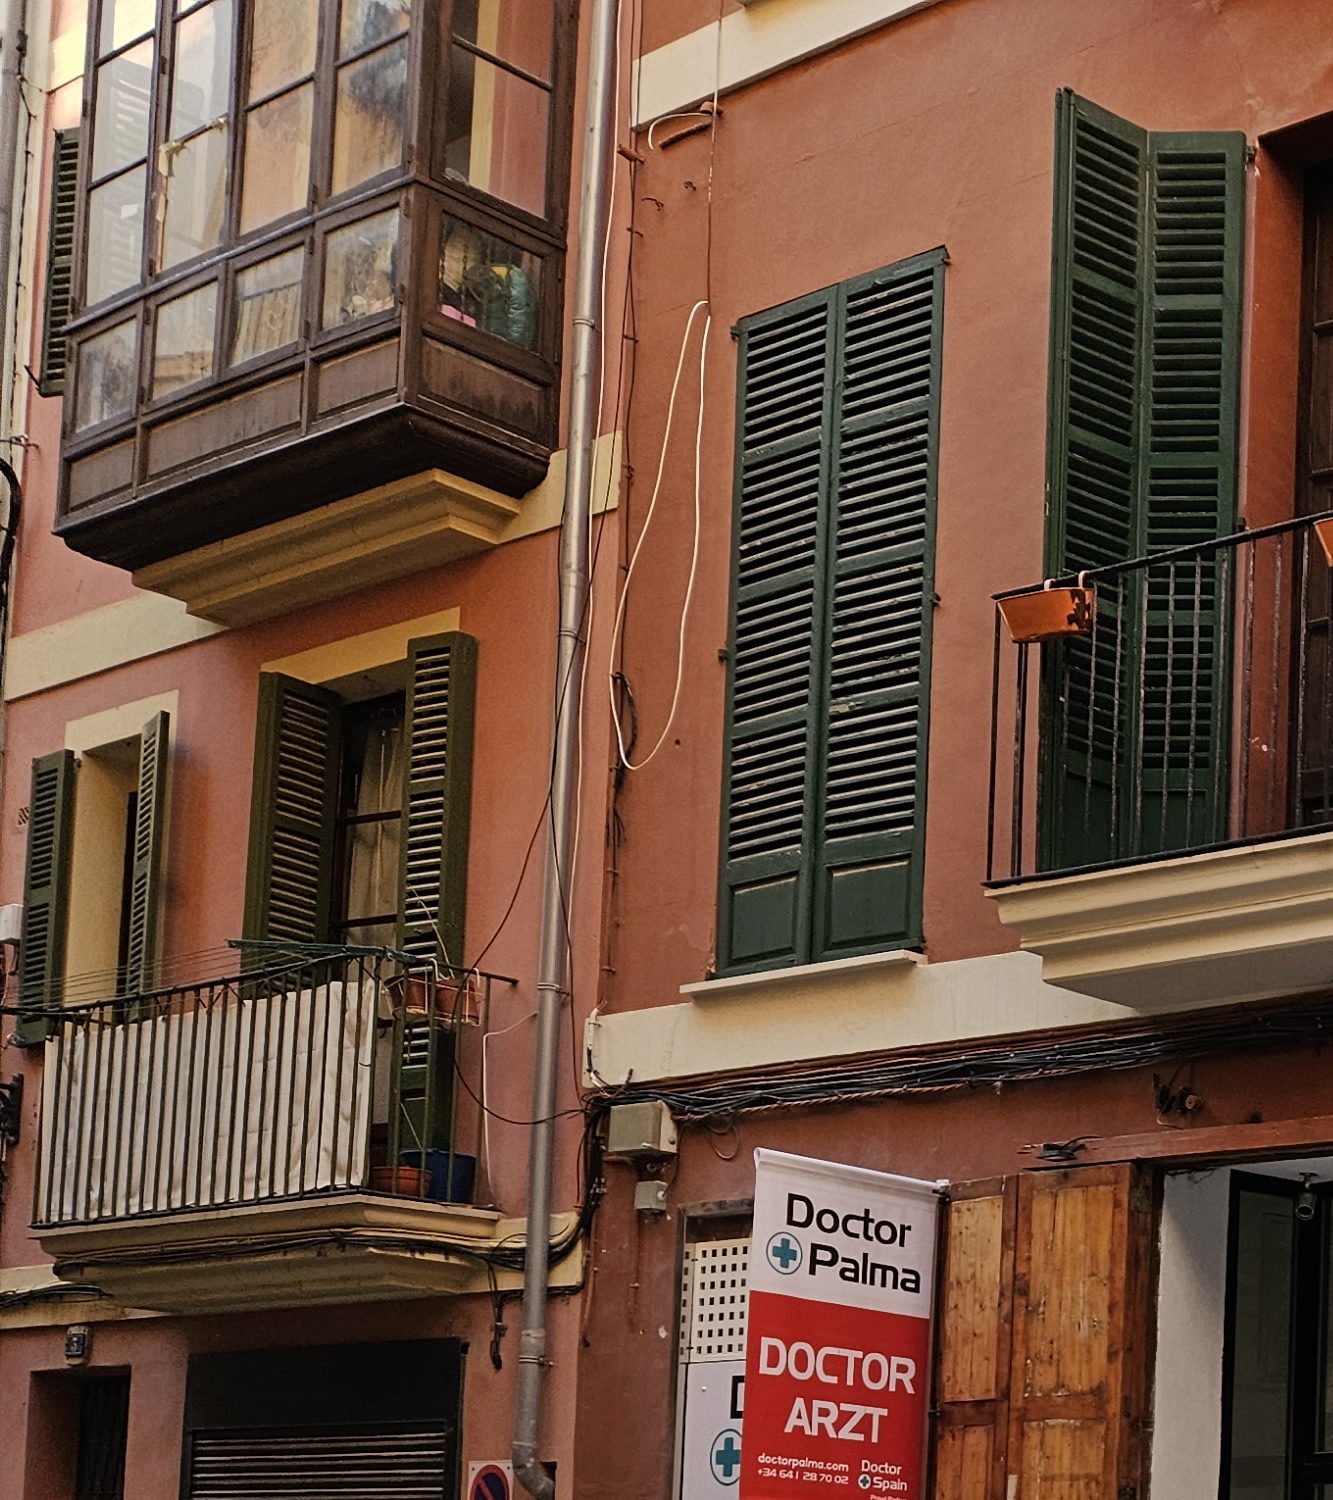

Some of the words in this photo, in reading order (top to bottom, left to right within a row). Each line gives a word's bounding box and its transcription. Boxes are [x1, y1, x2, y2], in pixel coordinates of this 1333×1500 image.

[786, 1193, 912, 1247] Doctor
[809, 1243, 920, 1294] Palma
[759, 1336, 916, 1394] DOCTOR
[784, 1397, 888, 1443] ARZT
[758, 1453, 849, 1472] doctorpalma.com
[758, 1468, 777, 1478] +34
[803, 1471, 818, 1482] 28
[819, 1473, 832, 1483] 70
[834, 1475, 849, 1485] 02
[861, 1459, 902, 1475] Doctor
[872, 1476, 908, 1492] Spain
